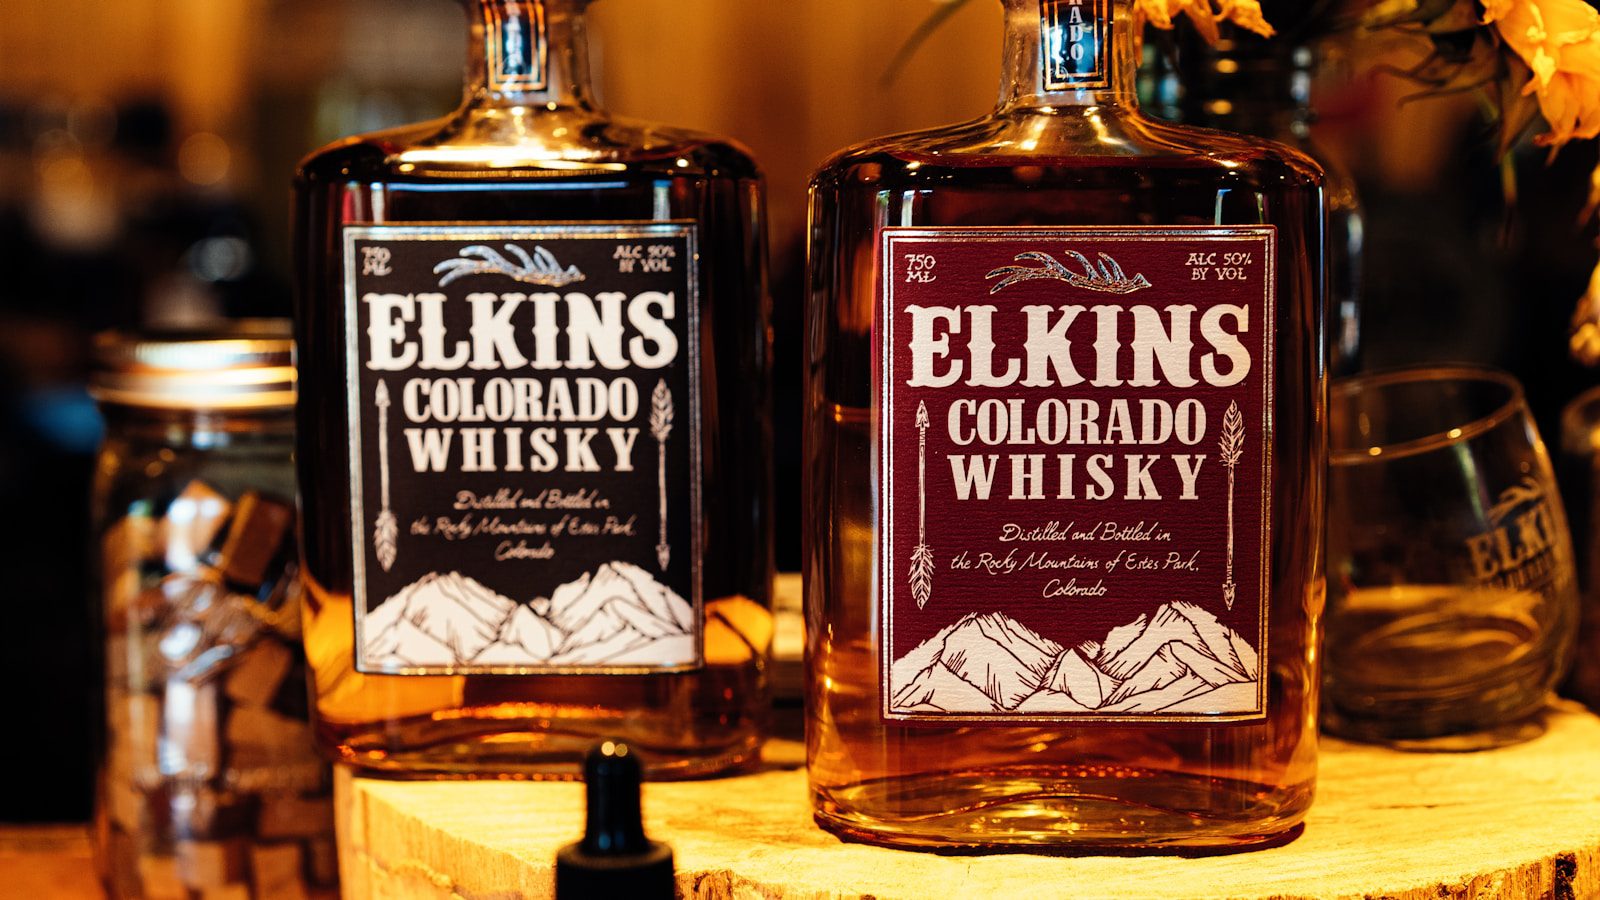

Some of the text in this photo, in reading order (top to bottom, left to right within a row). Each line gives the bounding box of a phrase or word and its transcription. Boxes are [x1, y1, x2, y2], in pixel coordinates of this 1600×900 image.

[613, 245, 642, 259] ALC
[904, 254, 936, 270] 750
[1184, 252, 1252, 266] ALC 50%
[640, 258, 672, 272] VOL
[1191, 267, 1247, 280] BY VOL
[905, 271, 936, 283] ML
[362, 291, 679, 371] ELKINS
[904, 303, 1252, 388] ELKINS
[402, 377, 639, 423] COLORADO
[947, 398, 1207, 446] COLORADO
[403, 427, 640, 472] WHISKY
[947, 453, 1208, 500] WHISKY
[999, 520, 1171, 542] Distilled and Bottled in
[950, 550, 971, 570] the
[974, 547, 1019, 576] Rocky
[1018, 551, 1100, 571] Mountains
[1105, 549, 1127, 573] of
[1125, 552, 1159, 571] Estes
[1042, 578, 1108, 598] Colorado
